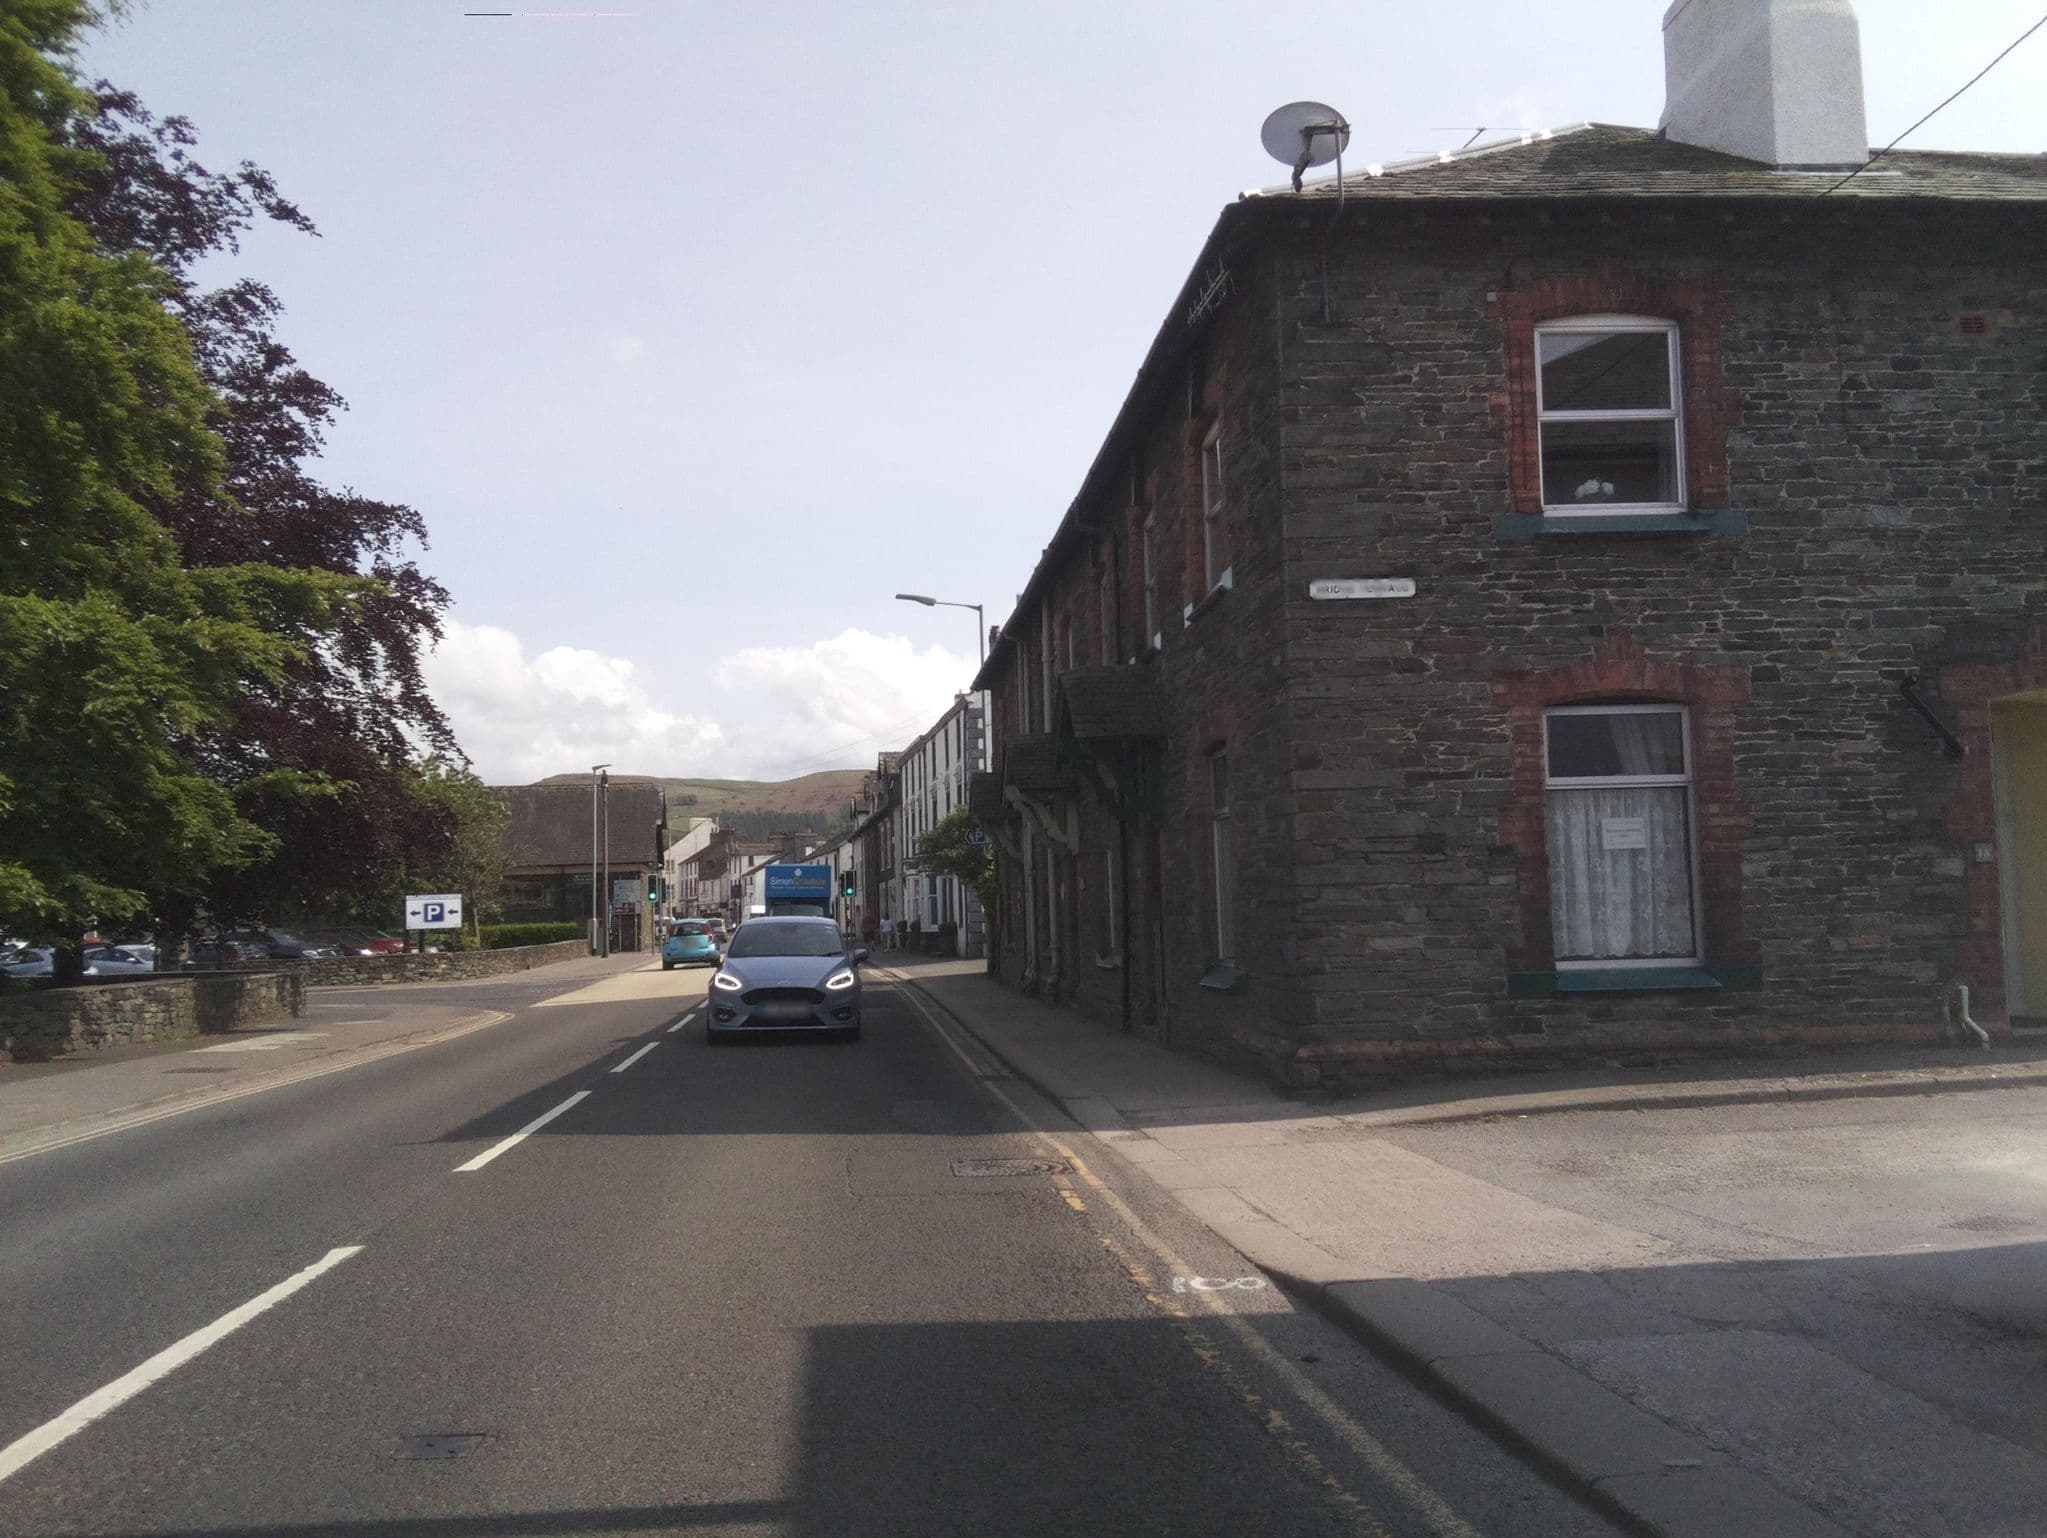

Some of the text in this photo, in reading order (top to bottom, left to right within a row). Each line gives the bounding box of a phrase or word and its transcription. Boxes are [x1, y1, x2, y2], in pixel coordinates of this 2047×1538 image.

[974, 831, 984, 842] P
[769, 876, 794, 886] Simon
[427, 904, 441, 921] P
